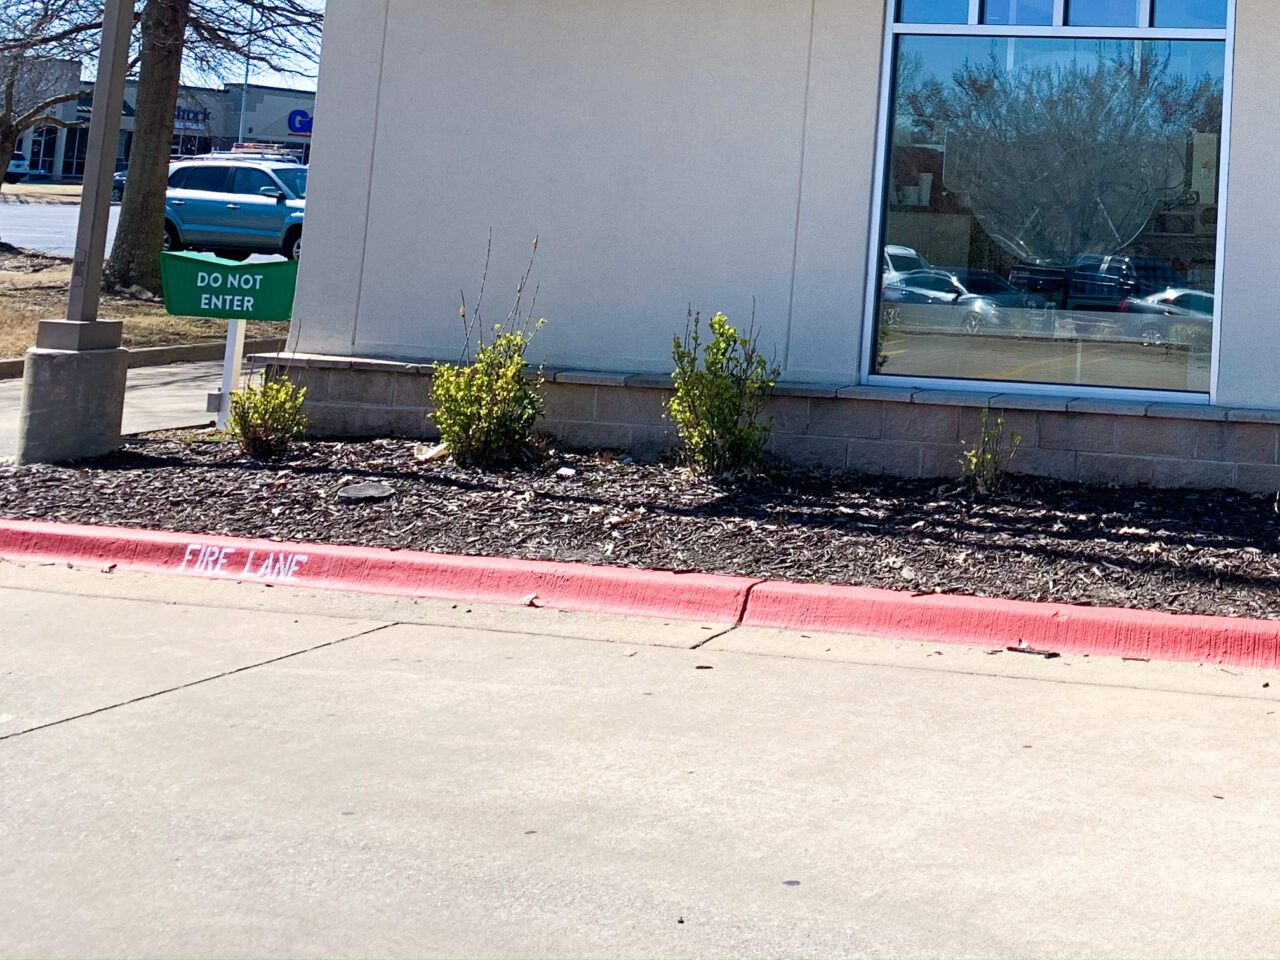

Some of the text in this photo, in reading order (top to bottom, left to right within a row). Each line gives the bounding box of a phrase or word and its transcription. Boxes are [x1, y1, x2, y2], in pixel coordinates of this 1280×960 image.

[197, 271, 263, 290] DO NOT
[201, 293, 254, 312] ENTER
[178, 544, 309, 581] FIRE LANE
